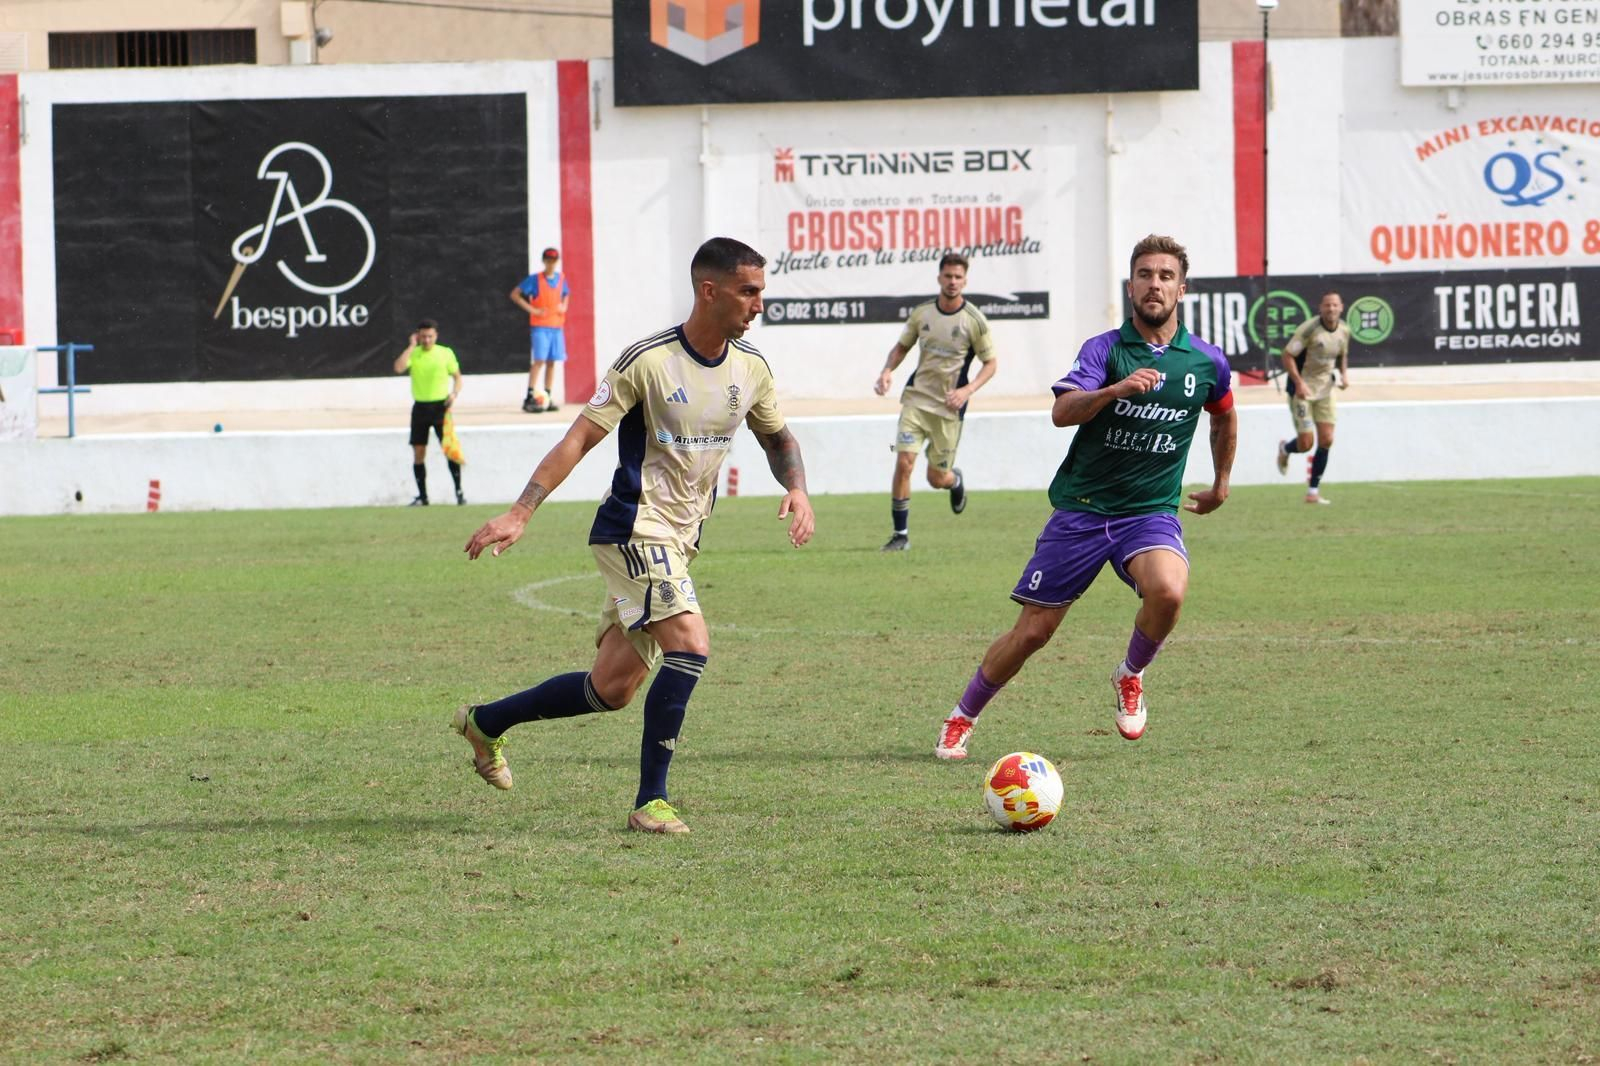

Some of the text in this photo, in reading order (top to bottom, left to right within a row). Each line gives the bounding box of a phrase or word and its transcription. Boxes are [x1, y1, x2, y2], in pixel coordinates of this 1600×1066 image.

[1436, 10, 1511, 26] OBRAS
[1499, 34, 1533, 49] 660
[1541, 33, 1575, 48] 294
[1479, 54, 1540, 67] TOTANA
[1553, 53, 1600, 65] MURC
[1415, 115, 1600, 161] MINI EXCAVACIO
[963, 149, 1032, 172] BOX
[1484, 151, 1564, 207] QS
[806, 192, 1003, 208] Único centro en Totana de
[787, 206, 1023, 252] CROSSTRAINING
[1370, 212, 1570, 265] QUIÑONERO
[771, 250, 831, 275] Hazte
[837, 253, 871, 269] con
[875, 247, 895, 265] tu
[231, 295, 369, 338] bespoke
[787, 302, 811, 319] 602
[814, 302, 830, 319] 13
[831, 301, 847, 318] 45
[851, 301, 865, 318] 11
[1434, 282, 1581, 331] TERCERA
[1178, 292, 1249, 355] TUR
[1434, 329, 1581, 350] FEDERACIÓN
[1184, 373, 1196, 398] 9
[1114, 397, 1189, 422] Ontime
[649, 544, 672, 576] 4
[1028, 570, 1043, 591] 9
